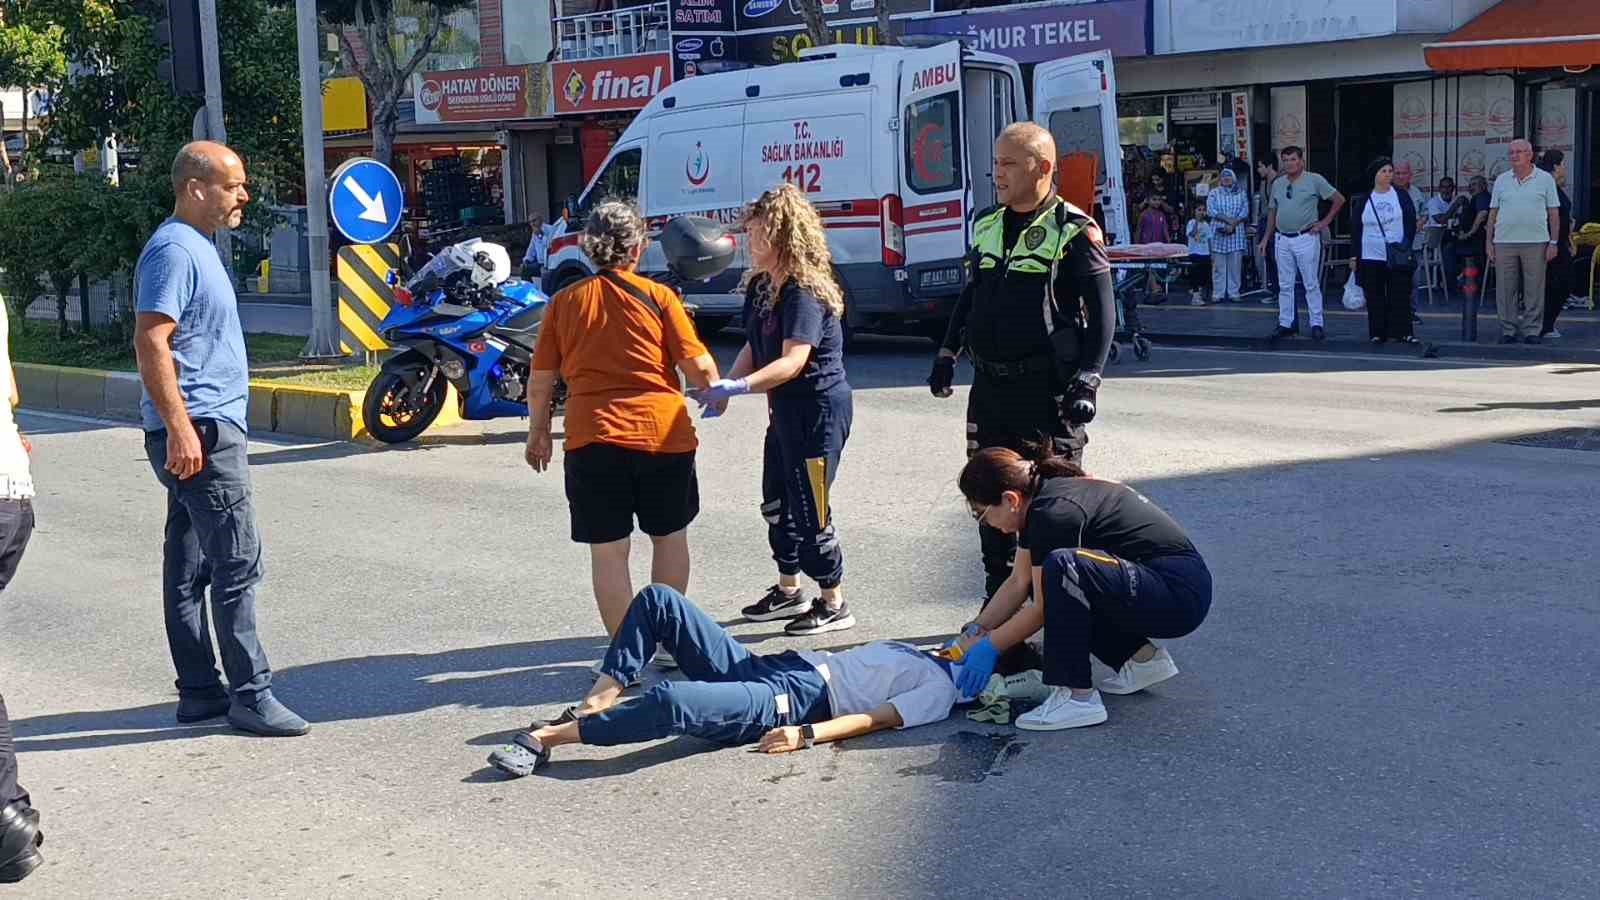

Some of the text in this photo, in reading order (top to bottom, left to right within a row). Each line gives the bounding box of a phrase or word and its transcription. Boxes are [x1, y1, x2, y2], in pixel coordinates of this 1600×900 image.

[1031, 19, 1101, 46] TEKEL
[442, 73, 520, 94] HATAY DÖNER
[591, 66, 663, 100] final
[912, 63, 956, 91] AMBU
[793, 122, 811, 139] T.C.
[762, 136, 844, 163] SAĞLIK BAKANLIĞI
[782, 163, 822, 193] 112
